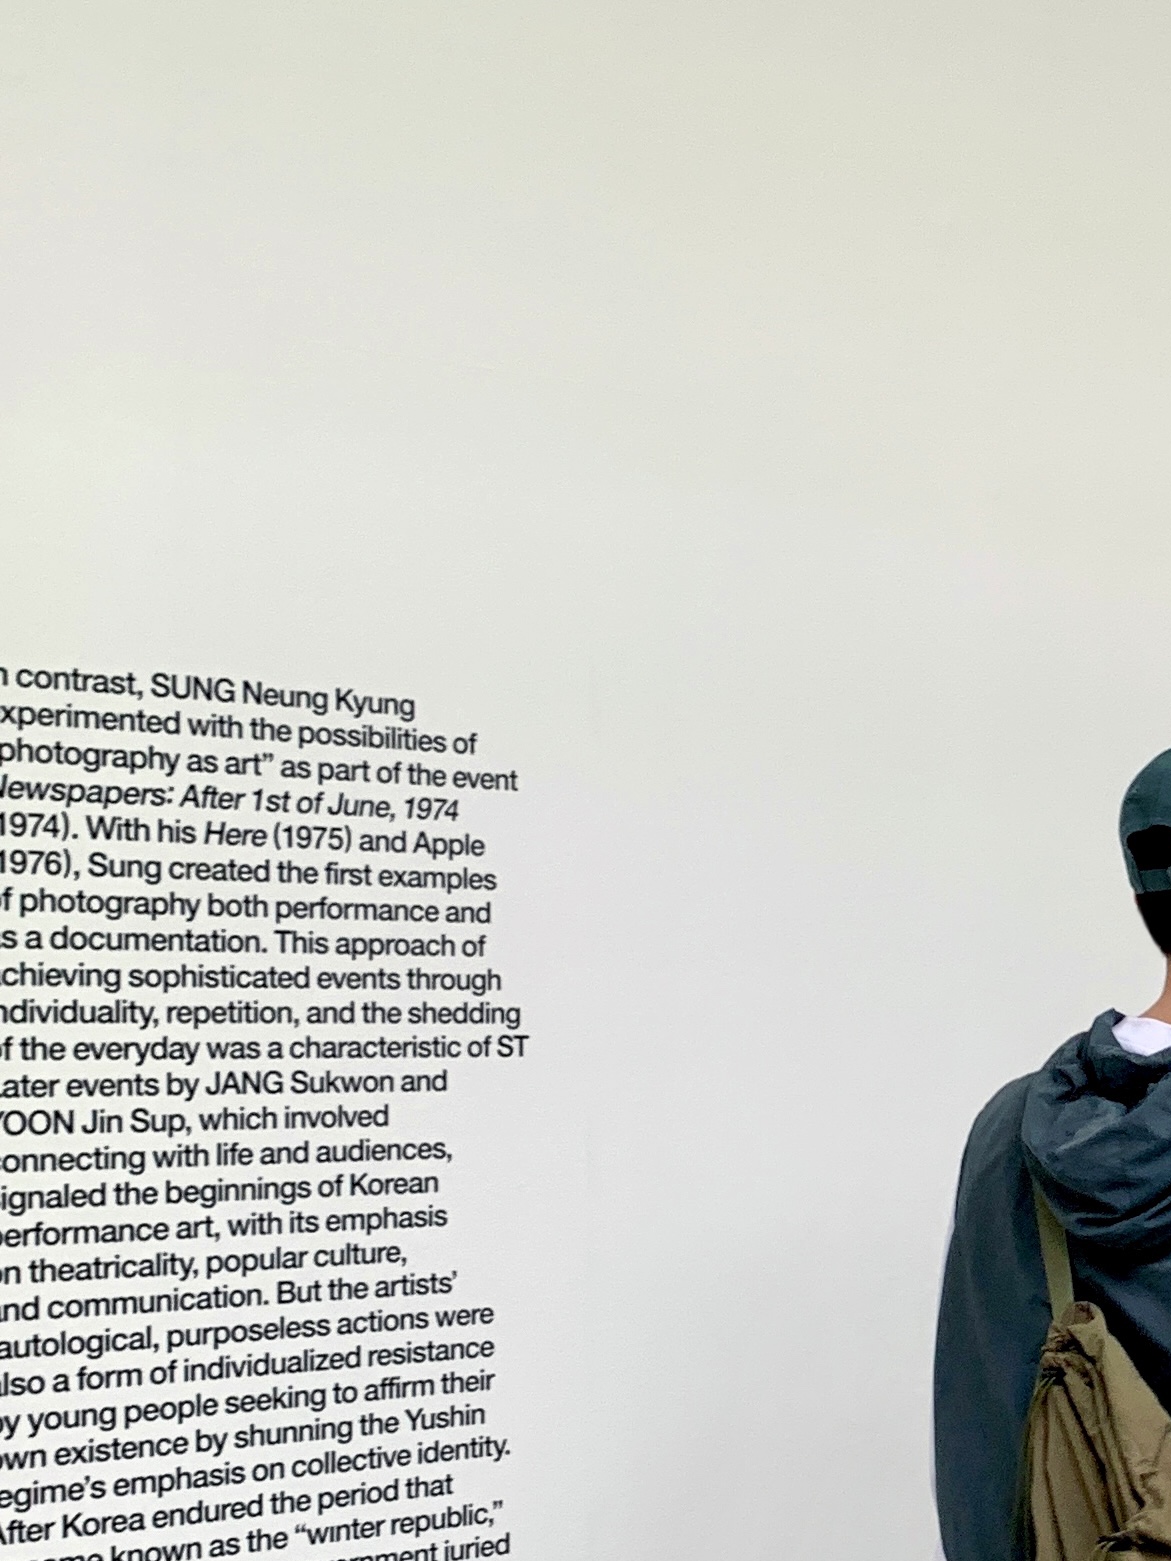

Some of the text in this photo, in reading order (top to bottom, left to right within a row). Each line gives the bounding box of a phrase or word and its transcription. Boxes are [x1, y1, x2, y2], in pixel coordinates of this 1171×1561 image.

[14, 667, 416, 724] contrast, SUNG Neung Kyung
[186, 712, 479, 756] with the possibilities of
[185, 753, 220, 775] as
[279, 759, 313, 780] as
[317, 759, 372, 786] part
[375, 760, 403, 785] of
[405, 762, 448, 788] the
[451, 769, 519, 792] event
[177, 783, 460, 823] After 1st of June, 1974
[84, 814, 486, 862] With his Here (1975) and Apple
[87, 851, 498, 896] Sung created the first examples
[18, 886, 492, 925] photography both performance and
[24, 924, 488, 962] a documentation. This approach of
[127, 962, 503, 998] sophisticated events through
[165, 999, 522, 1031] repetition, and the shedding
[17, 1033, 531, 1068] the everyday was a characteristic of ST
[65, 1068, 449, 1103] events by JANG Sukwon and
[80, 1102, 390, 1139] Jin Sup, which involved
[151, 1137, 453, 1169] with life and audiences,
[112, 1172, 440, 1210] the beginnings of Korean
[174, 1203, 449, 1243] art, with its emphasis
[26, 1241, 408, 1284] theatricality, popular culture,
[46, 1283, 270, 1321] communication.
[276, 1279, 323, 1306] But
[326, 1276, 370, 1302] the
[166, 1306, 495, 1355] purposeless actions were
[51, 1339, 496, 1394] a form of individualized resistance
[26, 1368, 497, 1439] young people seeking to affirm their
[53, 1402, 486, 1467] existence by shunning the Yushin
[112, 1434, 511, 1499] emphasis on collective identity.
[61, 1473, 455, 1540] Korea endured the period that
[208, 1536, 242, 1559] as
[244, 1527, 290, 1554] the
